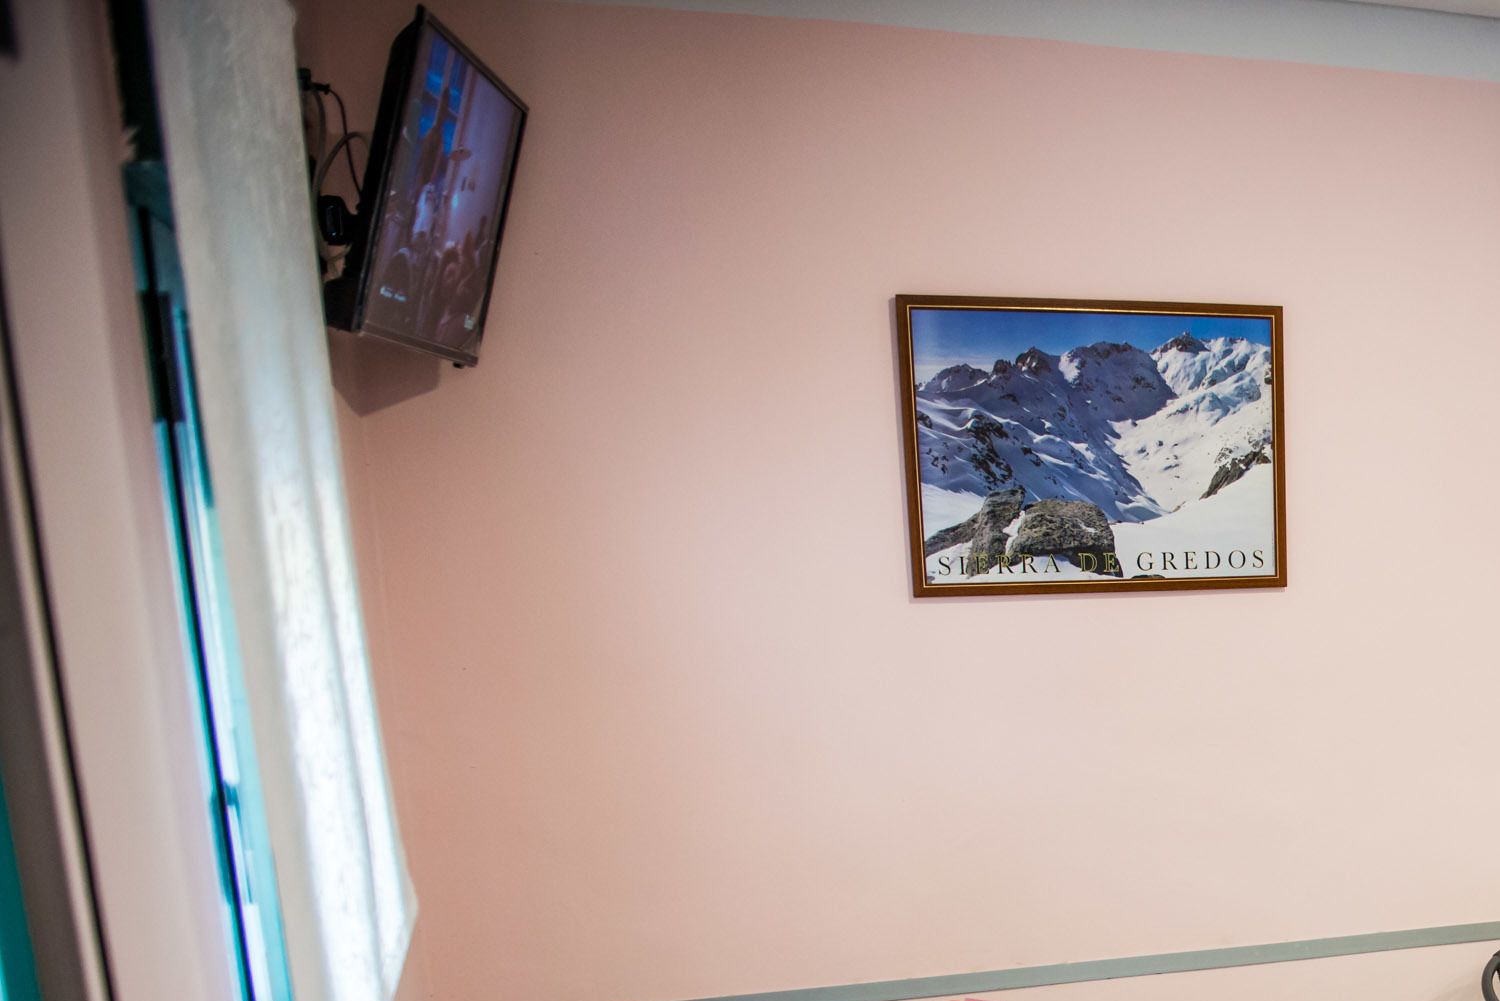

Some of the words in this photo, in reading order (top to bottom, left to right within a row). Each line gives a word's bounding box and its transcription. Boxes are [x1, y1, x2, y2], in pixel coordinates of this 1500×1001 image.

[938, 553, 1060, 576] SIERRA
[1077, 552, 1120, 573] DE
[1136, 549, 1266, 572] GREDOS
